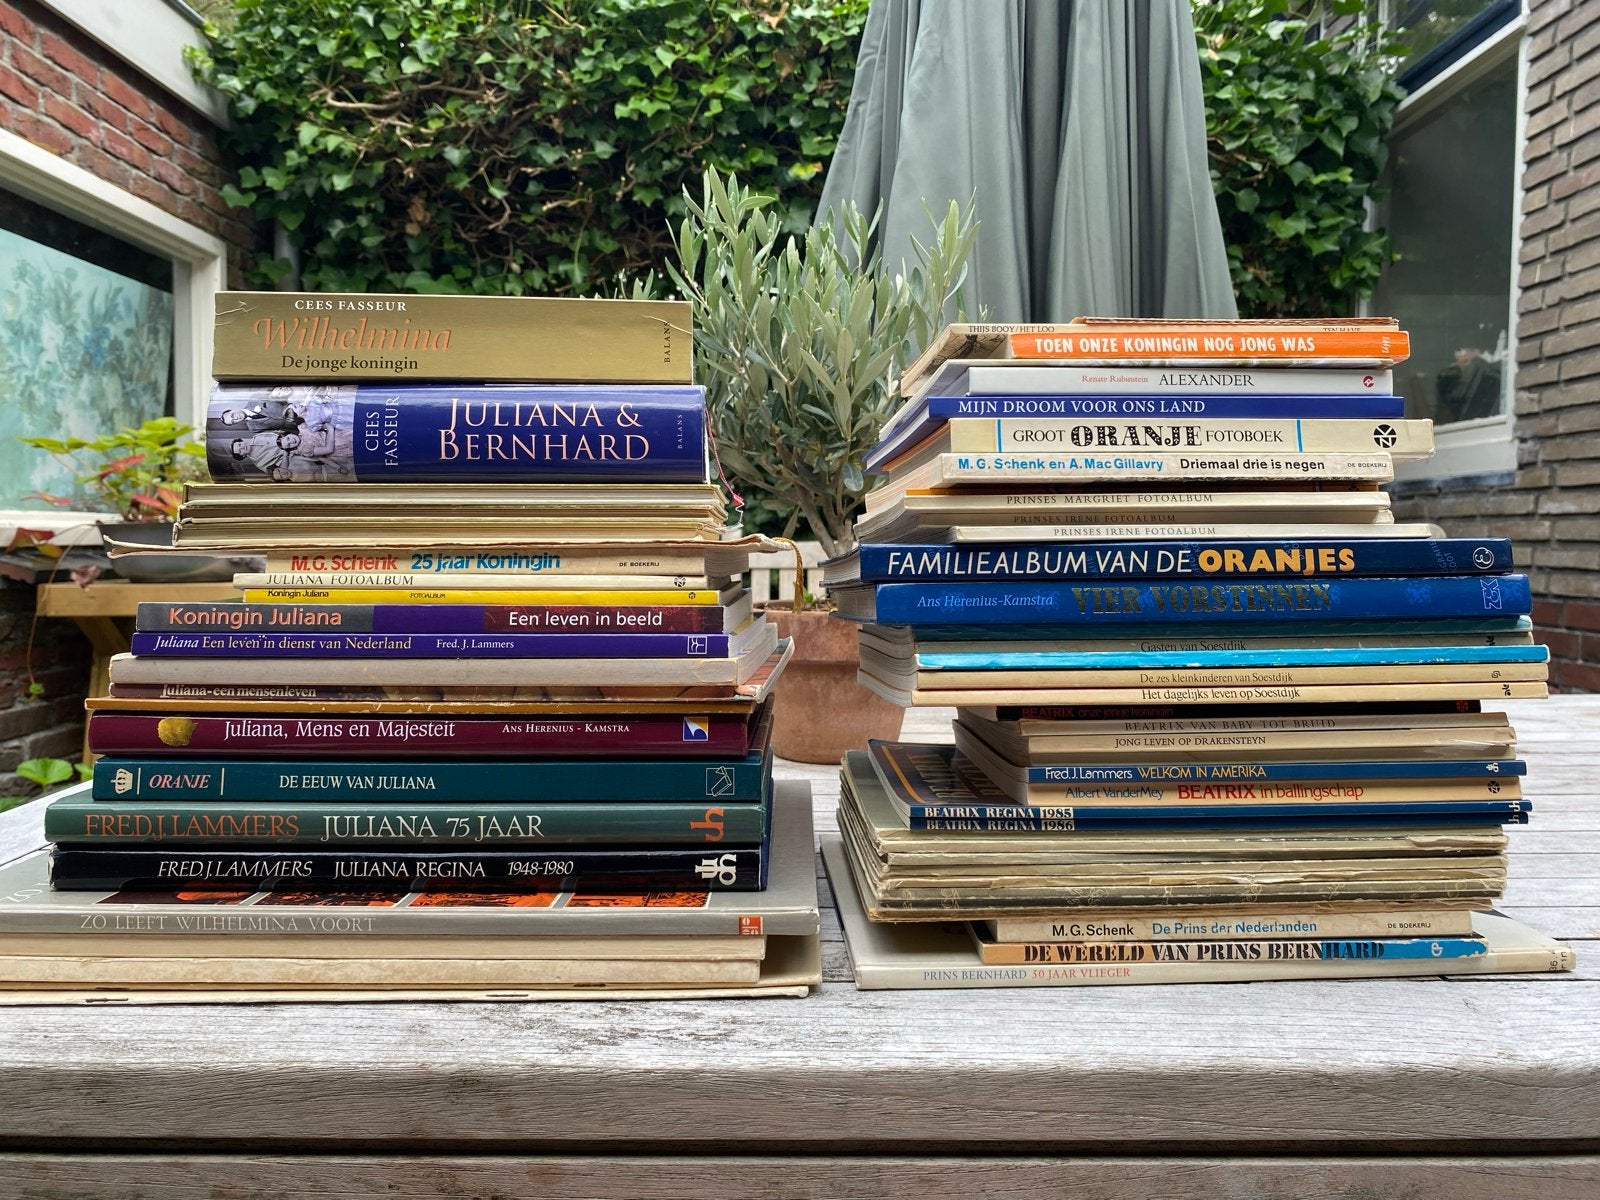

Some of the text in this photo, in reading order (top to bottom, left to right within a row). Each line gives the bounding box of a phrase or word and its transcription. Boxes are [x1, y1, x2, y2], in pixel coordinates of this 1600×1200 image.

[294, 299, 407, 312] CEES FASSEUR
[252, 316, 452, 352] Wilhelmina
[968, 325, 1055, 333] THIJS LOO
[1035, 336, 1316, 353] TOEN ONZE KONINGIN NOG JONG WAS
[281, 355, 419, 372] De jonge koningin
[1082, 374, 1255, 387] Renate Rubinstein ALEXANDER
[958, 400, 1205, 415] MIJN DROOM VOOR ONS LAND
[446, 398, 644, 435] JULIANA &
[365, 411, 380, 451] CEES
[384, 395, 400, 466] FASSEUR
[1013, 425, 1284, 447] GROOT ORANJE FOTOBOEK
[438, 429, 650, 461] BERNHARD
[994, 458, 1325, 472] Schenk en Driemaal drie is negen
[1006, 494, 1213, 504] PRINSES MARGRIET FOTOALBUM
[1013, 514, 1176, 523] PRINSES IRENE FOTOALBUM
[1053, 526, 1216, 536] PRINSES IRENE FOTOALBUM
[330, 554, 399, 571] Schenk
[410, 553, 433, 570] 25
[435, 553, 475, 572] jaar
[476, 552, 561, 571] Koningin
[887, 551, 1088, 575] FAMILIEALBUM
[1094, 550, 1148, 574] VAN
[1156, 550, 1193, 573] DE
[1198, 548, 1356, 576] ORANJES
[266, 574, 414, 585] JULIANA FOTOALBUM
[267, 590, 301, 599] Koningin
[302, 590, 329, 598] Juliana
[917, 583, 1331, 614] Ans Herenius-Kamstra VIER VORSTINNEN
[169, 607, 663, 629] Koningin Juliana Een leven in beeld
[153, 635, 515, 650] Juliana Een leven dienst van Nederland Fred. Lammers
[1140, 641, 1247, 652] Gasten Soestdijk
[1140, 672, 1293, 683] De zes kleinkinderen Soestdijk
[240, 685, 317, 698] mensenleven
[1142, 687, 1301, 702] Het dagelijks leven op Soestdijk
[1022, 707, 1074, 718] BEATRIX
[223, 720, 456, 742] Juliana, Mens en Majesteit
[1125, 718, 1336, 731] BEATRIX VAN BABY TOT BRUID
[1115, 736, 1266, 749] JONG LEVEN OP DRAKENSTEYN
[1137, 765, 1266, 779] WELKOM IN AMERIKA
[149, 774, 436, 790] ORANJE DE EEUW VAN JULIANA
[1065, 783, 1364, 801] Albert VanderMey BEATRIX in ballingschap
[924, 807, 1073, 819] BEATRIX REGINA 1985
[320, 815, 545, 842] JULIANA 75 JAAR
[926, 819, 1074, 831] BEATRIX REGINA 1986
[333, 860, 574, 880] JULIANA REGINA 1948-1980
[80, 914, 376, 932] ZO LEEFT WILHELMINA VOORT
[1152, 923, 1171, 935] De
[1174, 922, 1208, 935] Prins
[1211, 921, 1231, 934] der
[1235, 921, 1317, 933] Nederlanden
[1024, 942, 1385, 962] DE WERELD VAN PRINS BERNHARD
[923, 967, 1131, 982] PRINS BERNHARD 50 JAAR VLIEGER
